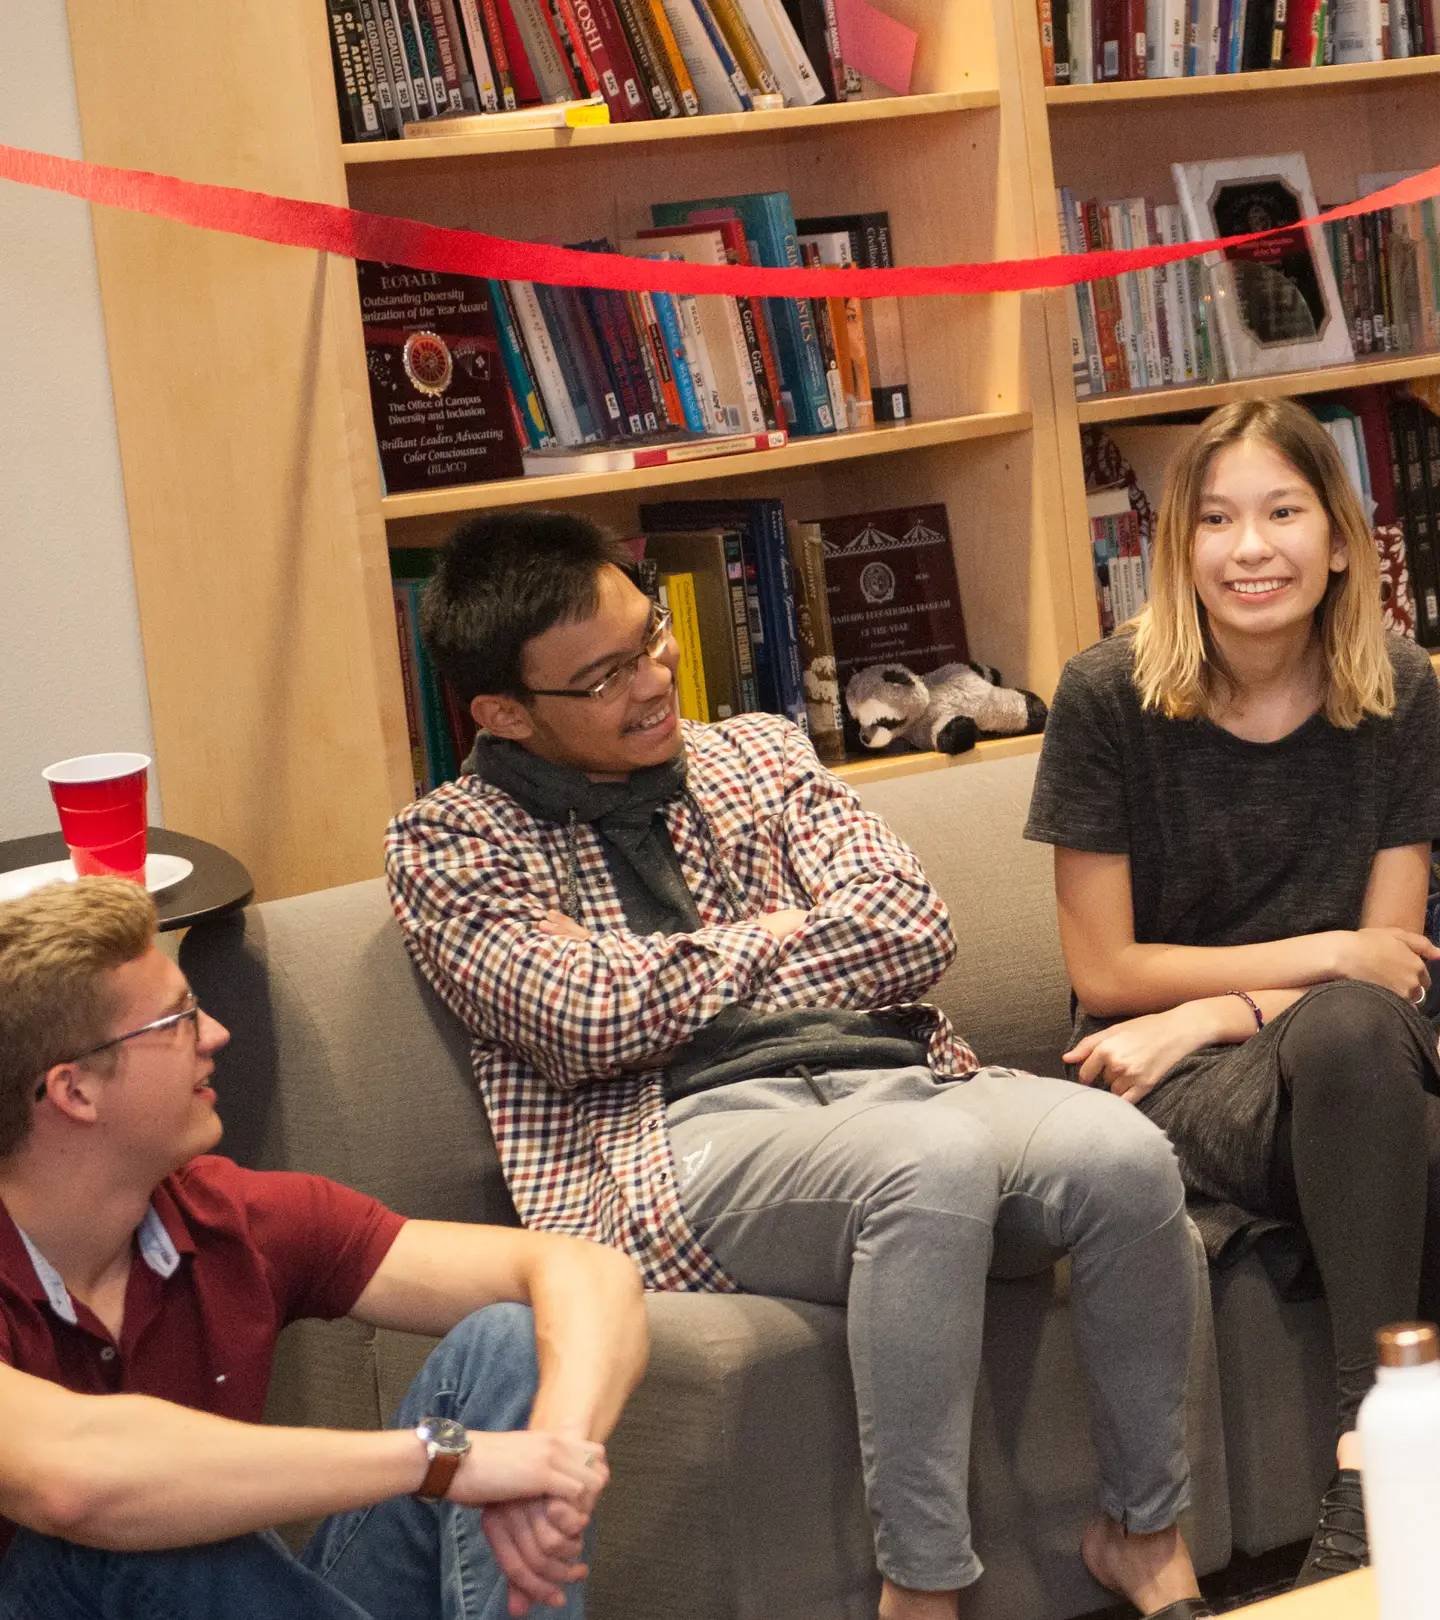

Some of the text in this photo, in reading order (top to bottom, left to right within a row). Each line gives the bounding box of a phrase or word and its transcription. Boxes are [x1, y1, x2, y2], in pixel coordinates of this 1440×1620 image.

[332, 13, 356, 95] AMERICANS
[344, 12, 370, 106] OF AFRICAN
[366, 20, 386, 84] GLOBALIZATI
[384, 18, 404, 81] GLOBALIZATI
[363, 288, 464, 308] Outstanding Diversity
[407, 308, 418, 321] of
[420, 306, 435, 318] the
[437, 305, 456, 316] Year
[458, 301, 488, 314] Award
[743, 312, 762, 376] Grace Grit
[389, 395, 482, 412] The Office of Campus
[389, 407, 485, 427] Diversity and Inclusion
[381, 427, 505, 450] Brilliant Leaders Advocating
[403, 446, 487, 464] Color Consciousness
